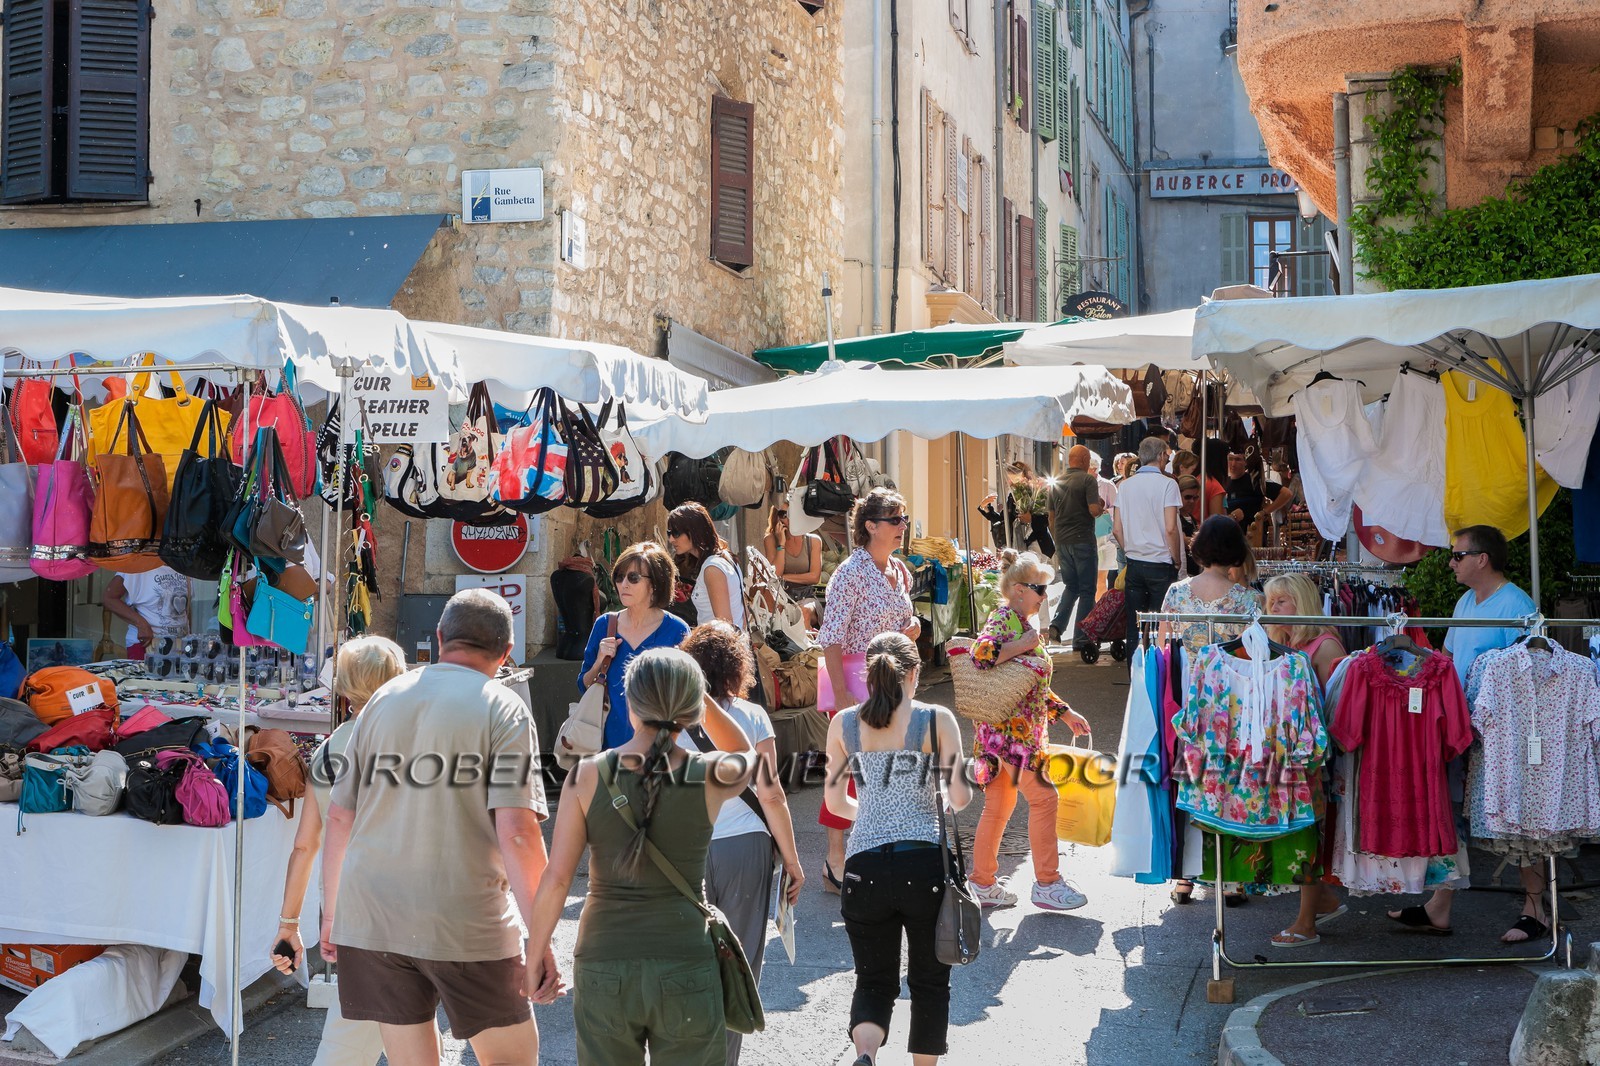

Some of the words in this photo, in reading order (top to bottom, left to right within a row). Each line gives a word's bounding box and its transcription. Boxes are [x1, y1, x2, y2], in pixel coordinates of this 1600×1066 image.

[1155, 173, 1245, 191] AUBERGE
[494, 187, 511, 196] Rue
[494, 196, 535, 206] Gambetta
[1076, 296, 1121, 311] RESTAURANT
[353, 376, 391, 391] CUIR
[371, 422, 419, 437] PELLE
[72, 690, 85, 700] CUIR
